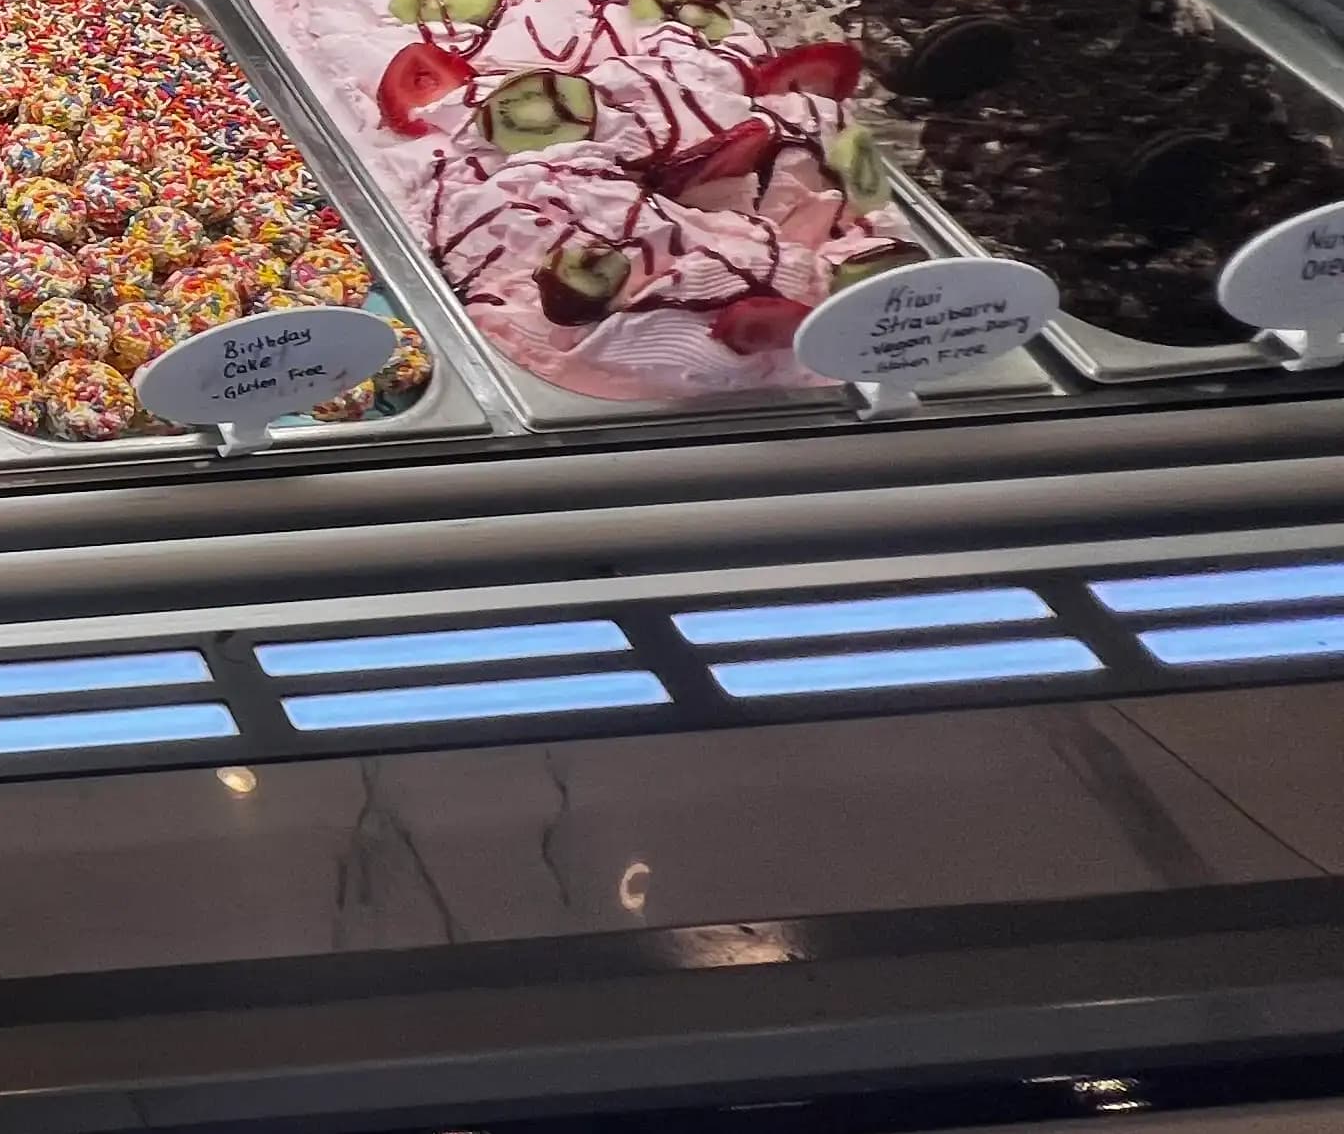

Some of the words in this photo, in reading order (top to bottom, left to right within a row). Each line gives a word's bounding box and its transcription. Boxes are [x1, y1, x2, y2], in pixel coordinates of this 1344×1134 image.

[884, 285, 943, 313] Kiwi
[223, 328, 312, 359] Birthday
[938, 344, 987, 363] Free
[224, 356, 272, 378] Cake
[288, 364, 328, 380] Free
